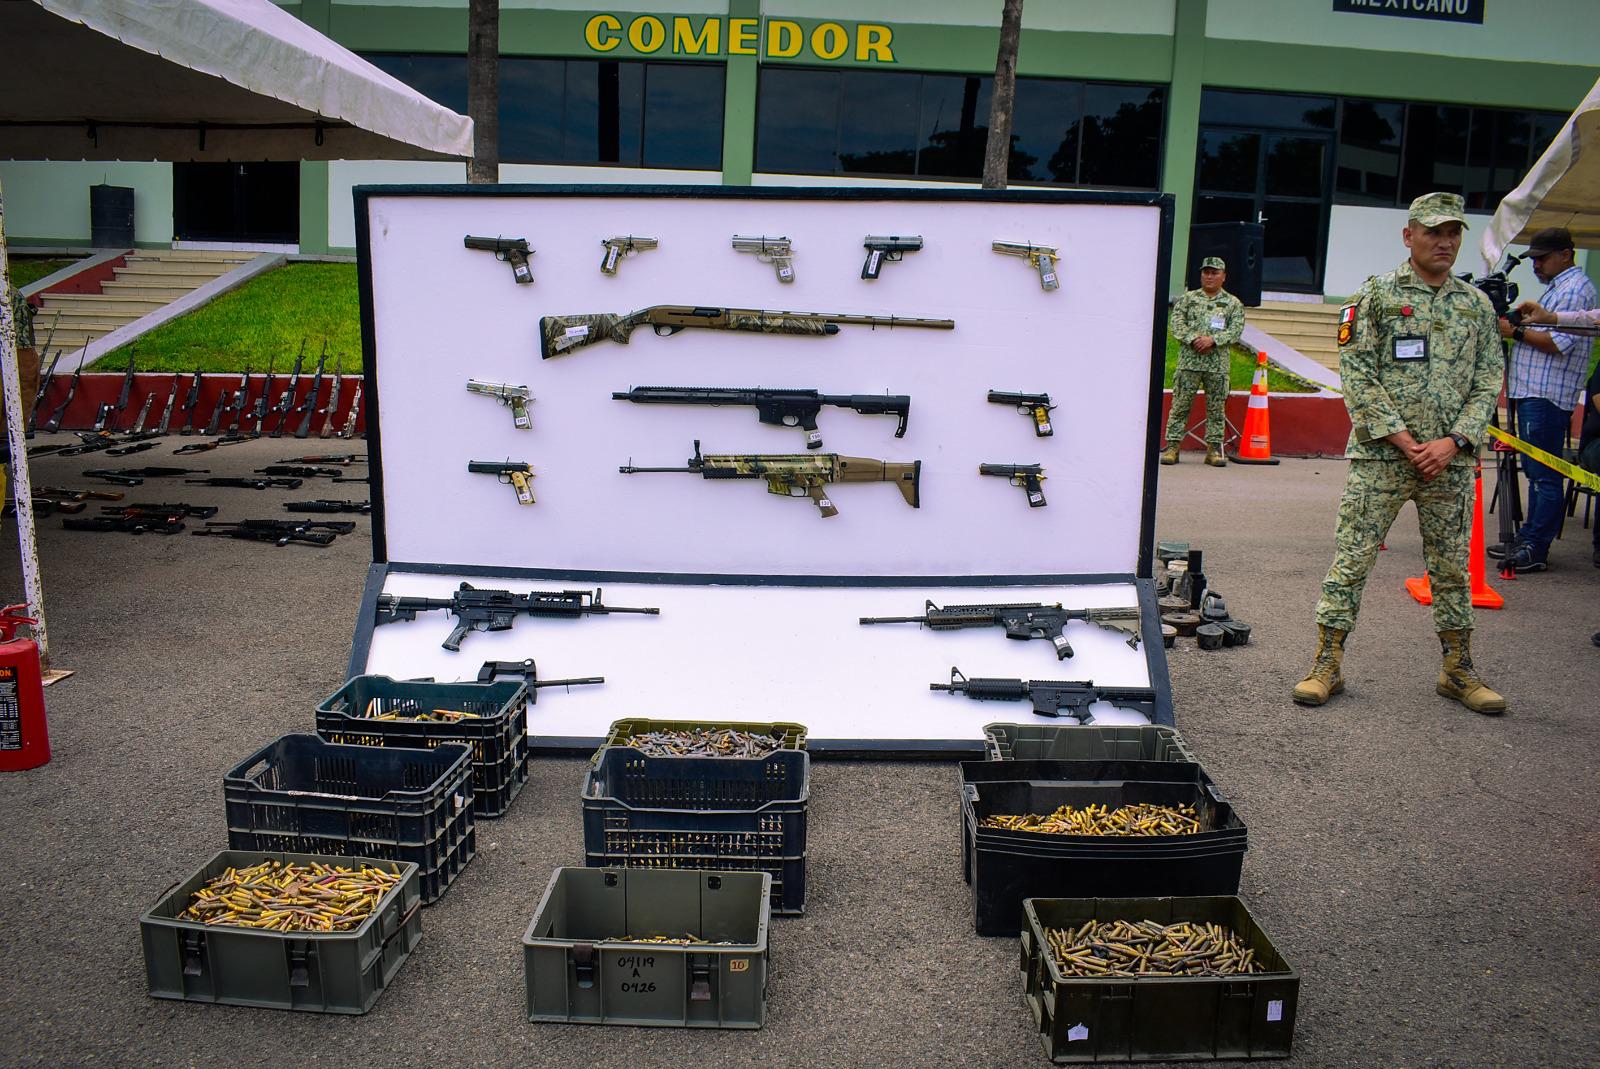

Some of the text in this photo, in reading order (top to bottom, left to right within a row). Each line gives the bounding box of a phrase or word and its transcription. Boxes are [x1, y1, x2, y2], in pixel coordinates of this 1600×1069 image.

[584, 14, 897, 63] COMEDOR
[731, 960, 744, 969] 10
[621, 982, 656, 992] 0426
